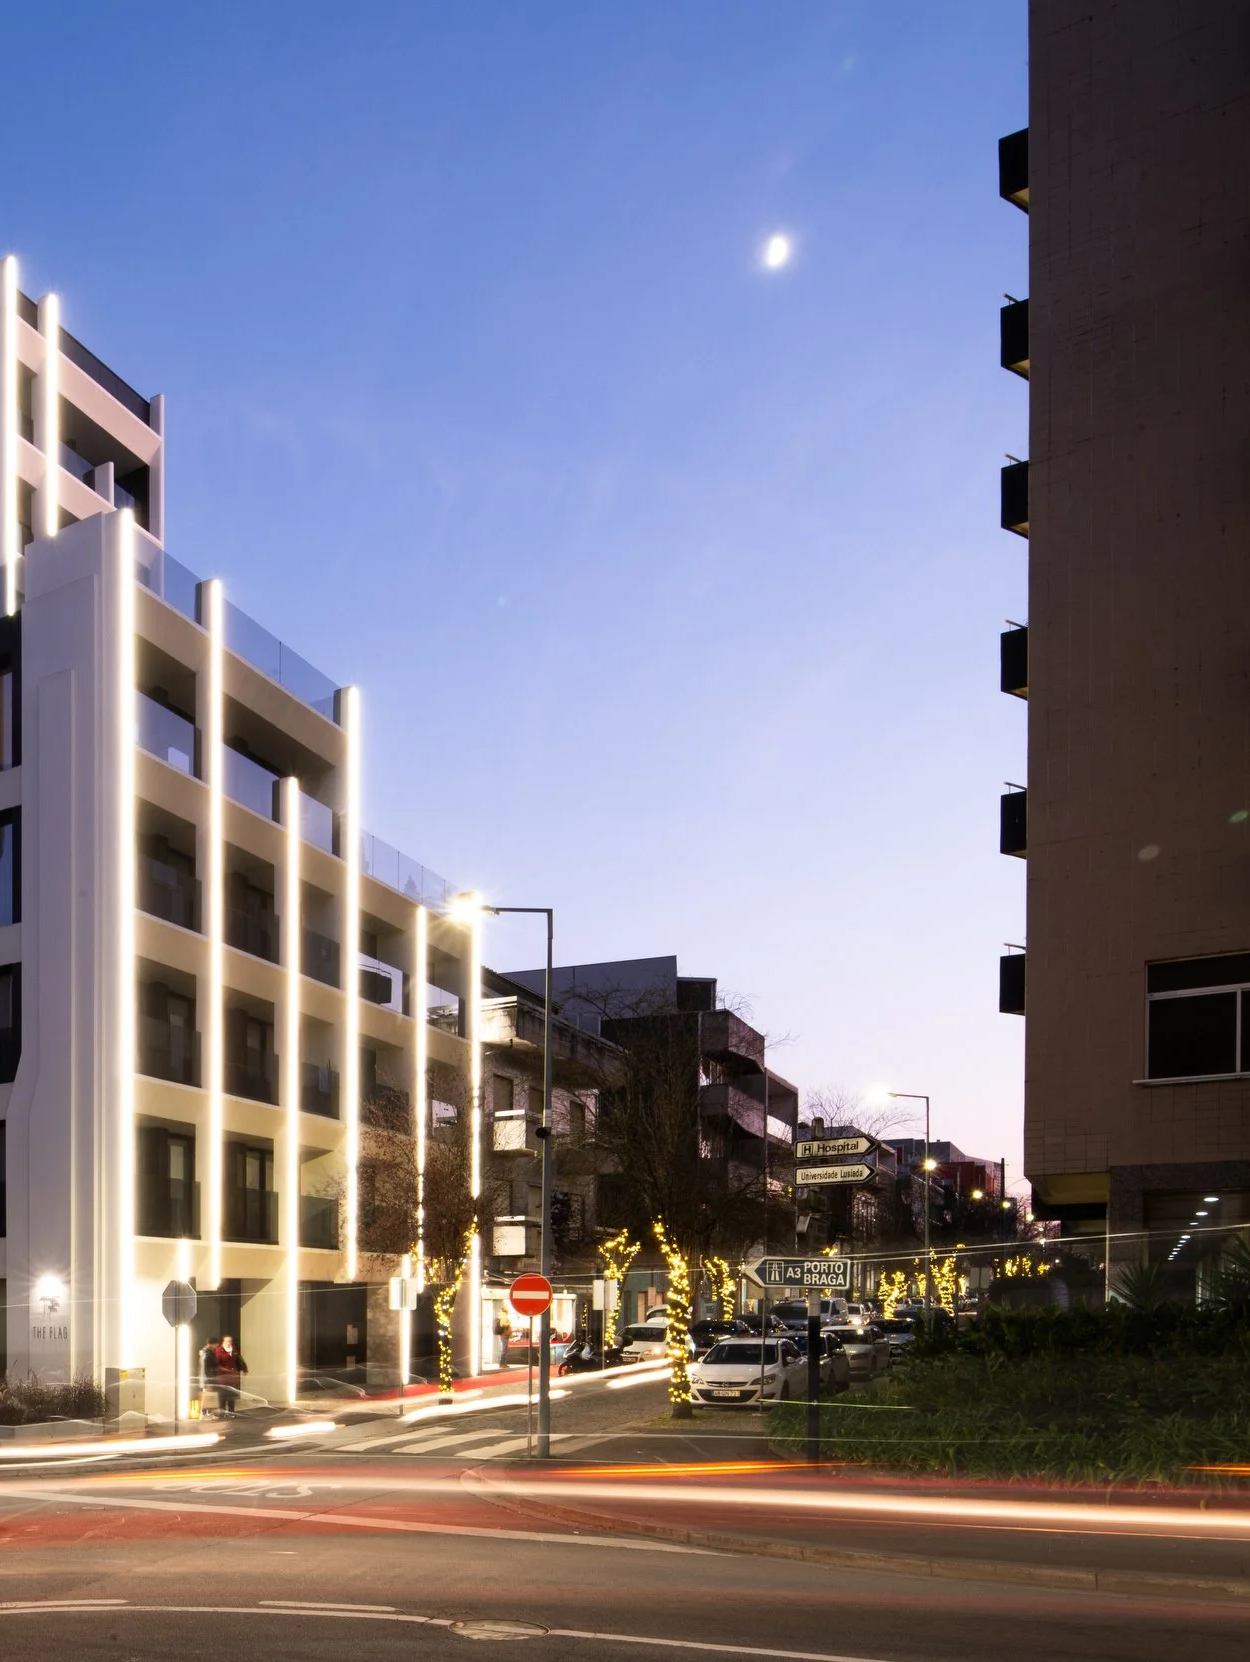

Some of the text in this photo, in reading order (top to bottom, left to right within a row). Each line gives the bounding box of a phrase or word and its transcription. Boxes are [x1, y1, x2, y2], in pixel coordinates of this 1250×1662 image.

[803, 1141, 859, 1154] H Hospital
[800, 1170, 838, 1181] Universidade
[786, 1267, 802, 1279] A3
[803, 1261, 844, 1274] PORTO
[803, 1273, 845, 1286] BRAGA
[33, 1326, 68, 1340] THE FLAG
